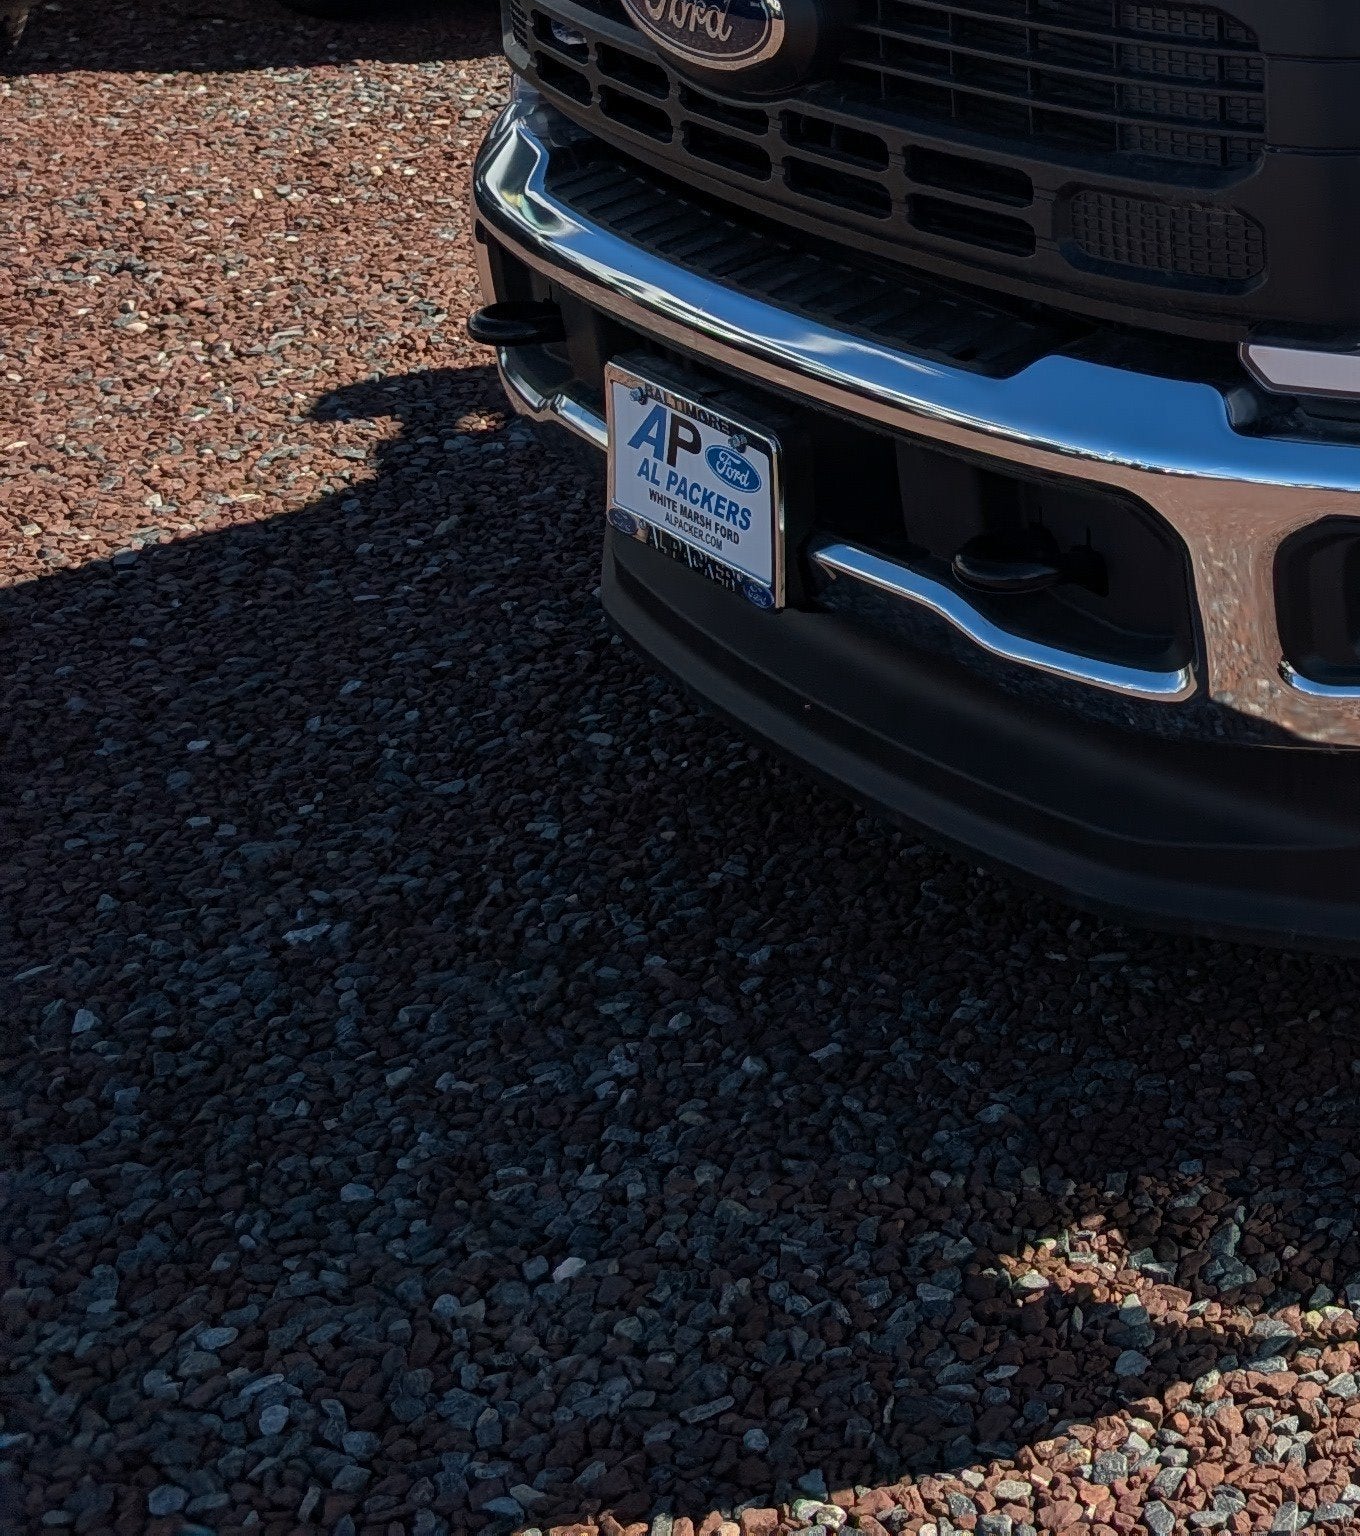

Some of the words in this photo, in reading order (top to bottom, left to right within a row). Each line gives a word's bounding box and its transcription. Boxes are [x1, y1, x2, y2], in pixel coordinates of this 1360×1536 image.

[627, 403, 702, 468] AP
[713, 446, 751, 488] Ford
[636, 457, 661, 488] AL
[665, 472, 752, 532] PACKERS
[648, 488, 678, 514] WHITE
[679, 504, 712, 535] MARSH
[714, 522, 740, 546] FORD
[664, 512, 723, 552] ALPACKER.COM
